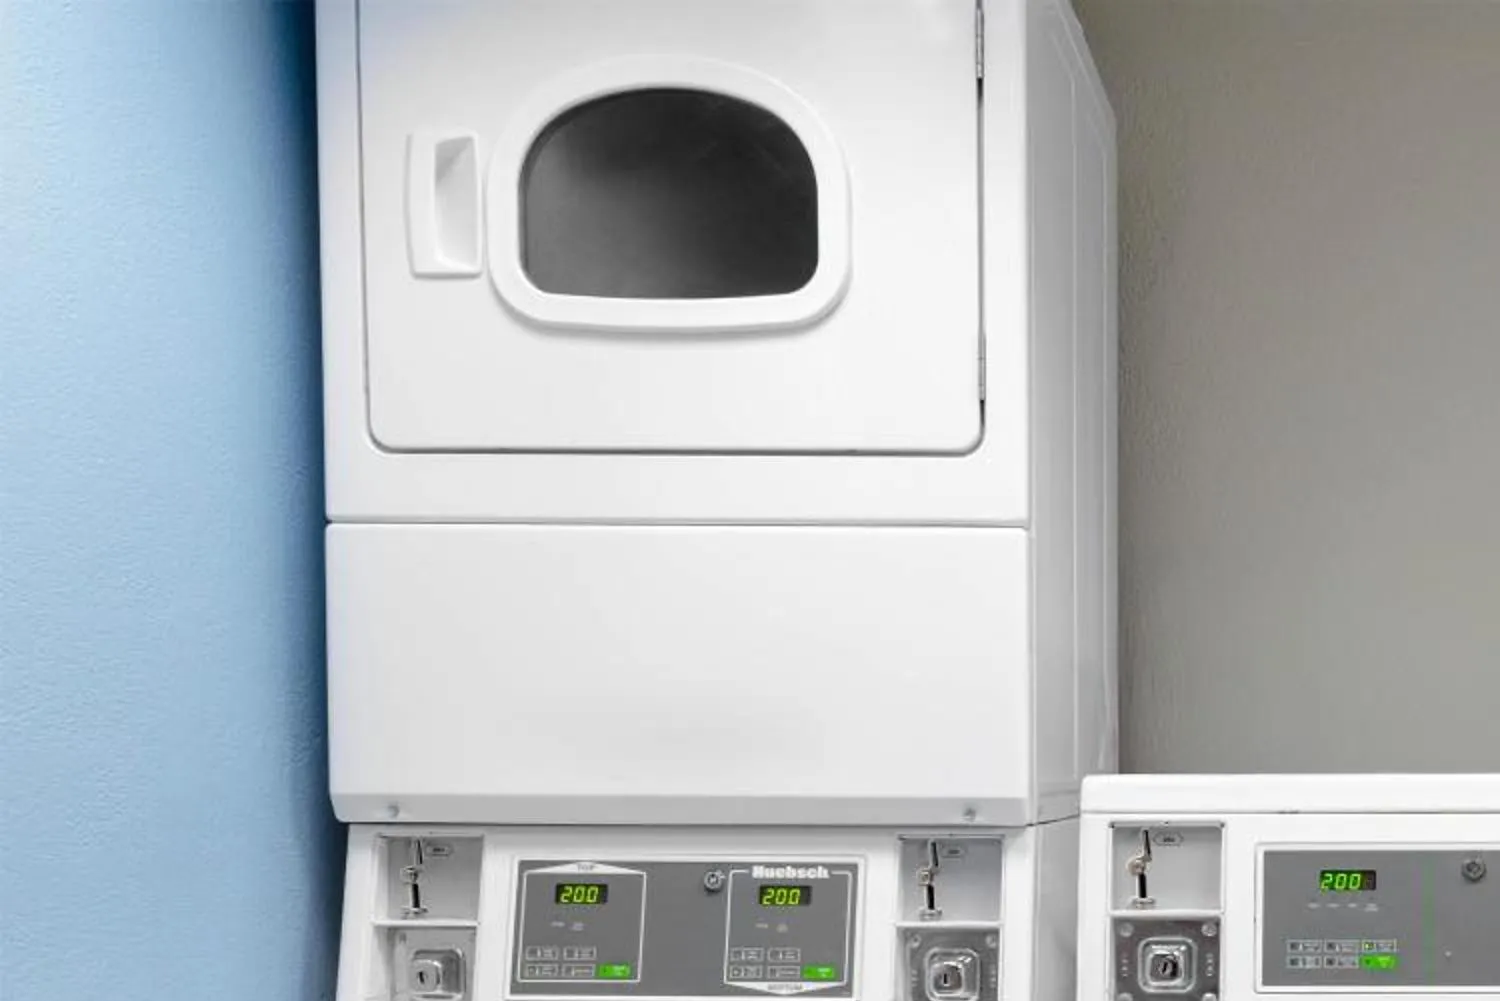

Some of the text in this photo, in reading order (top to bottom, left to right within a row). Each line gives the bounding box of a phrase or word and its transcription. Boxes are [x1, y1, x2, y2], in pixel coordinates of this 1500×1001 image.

[752, 865, 829, 879] Huebsch
[1321, 873, 1361, 889] 200
[560, 885, 599, 903] 200
[762, 887, 801, 905] 200
